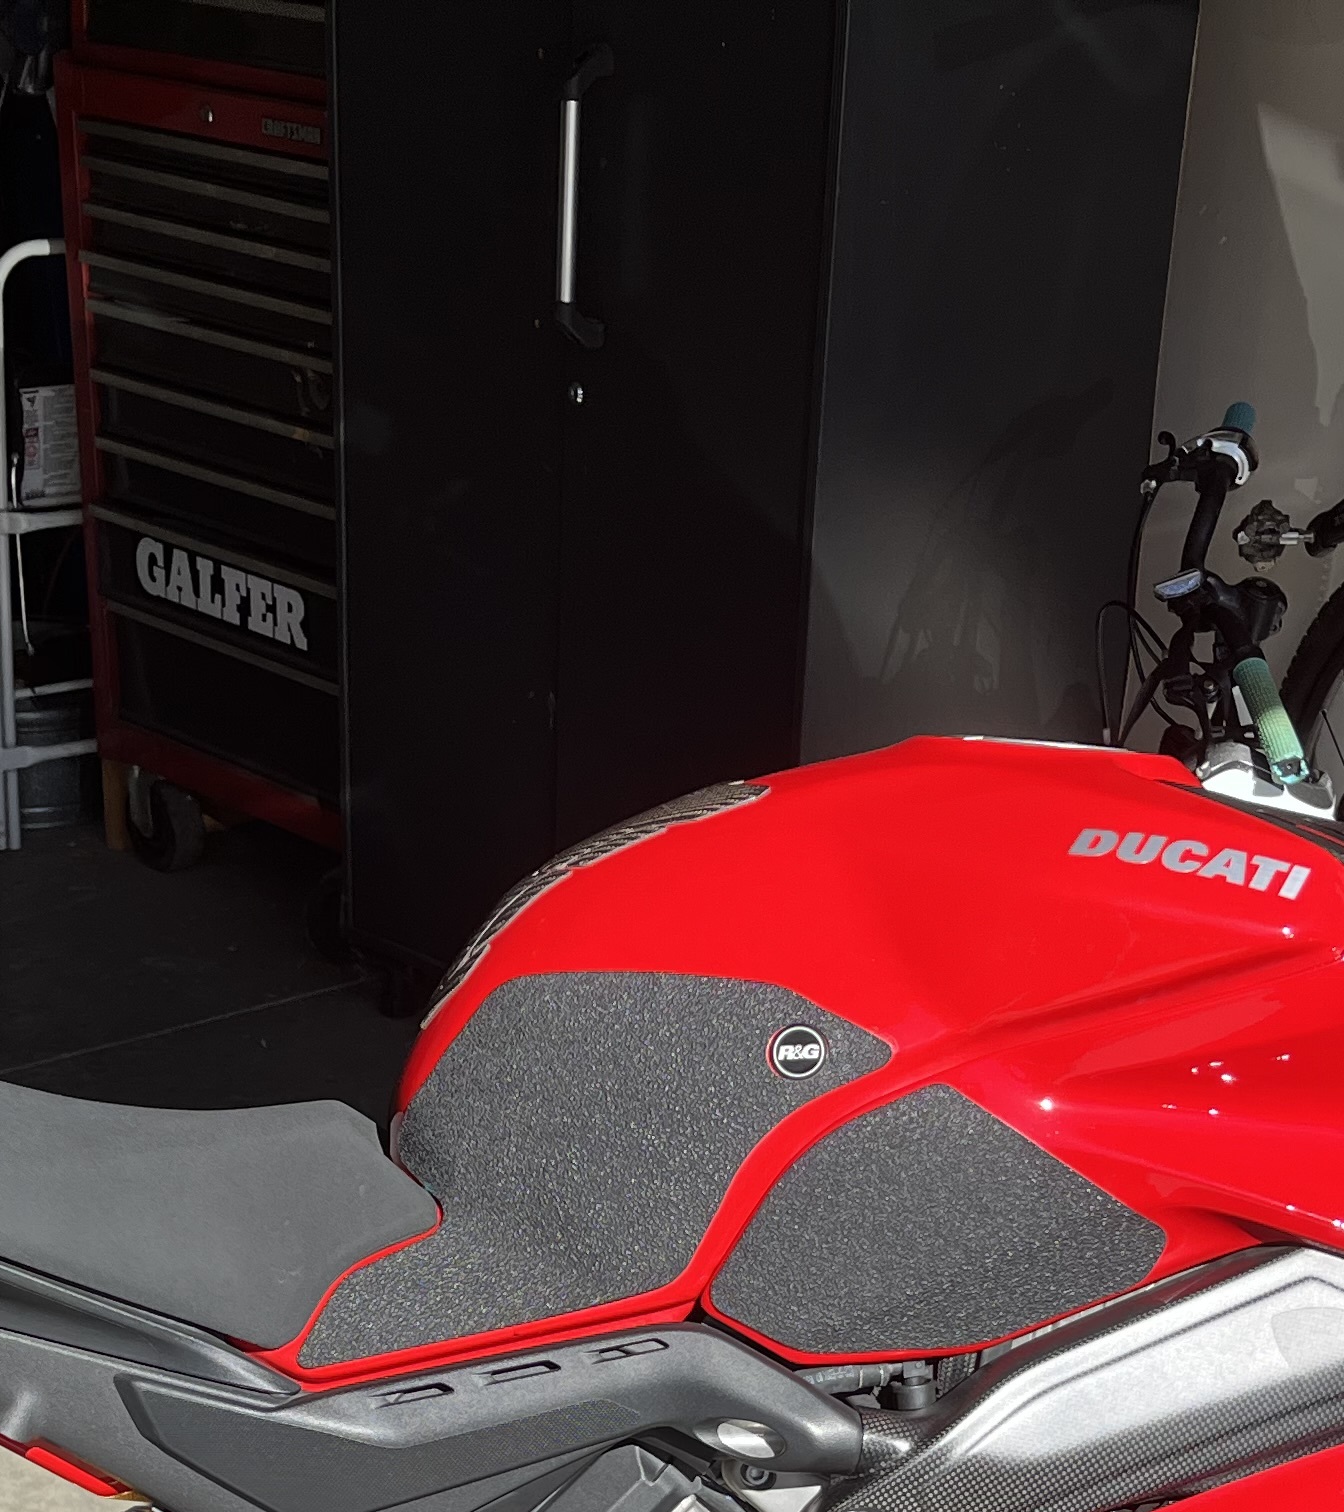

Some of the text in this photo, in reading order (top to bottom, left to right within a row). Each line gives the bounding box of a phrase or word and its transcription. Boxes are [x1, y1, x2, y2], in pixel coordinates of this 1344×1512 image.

[135, 536, 308, 652] GALFER
[1068, 828, 1312, 900] DUCATI
[777, 1043, 820, 1061] R&G
